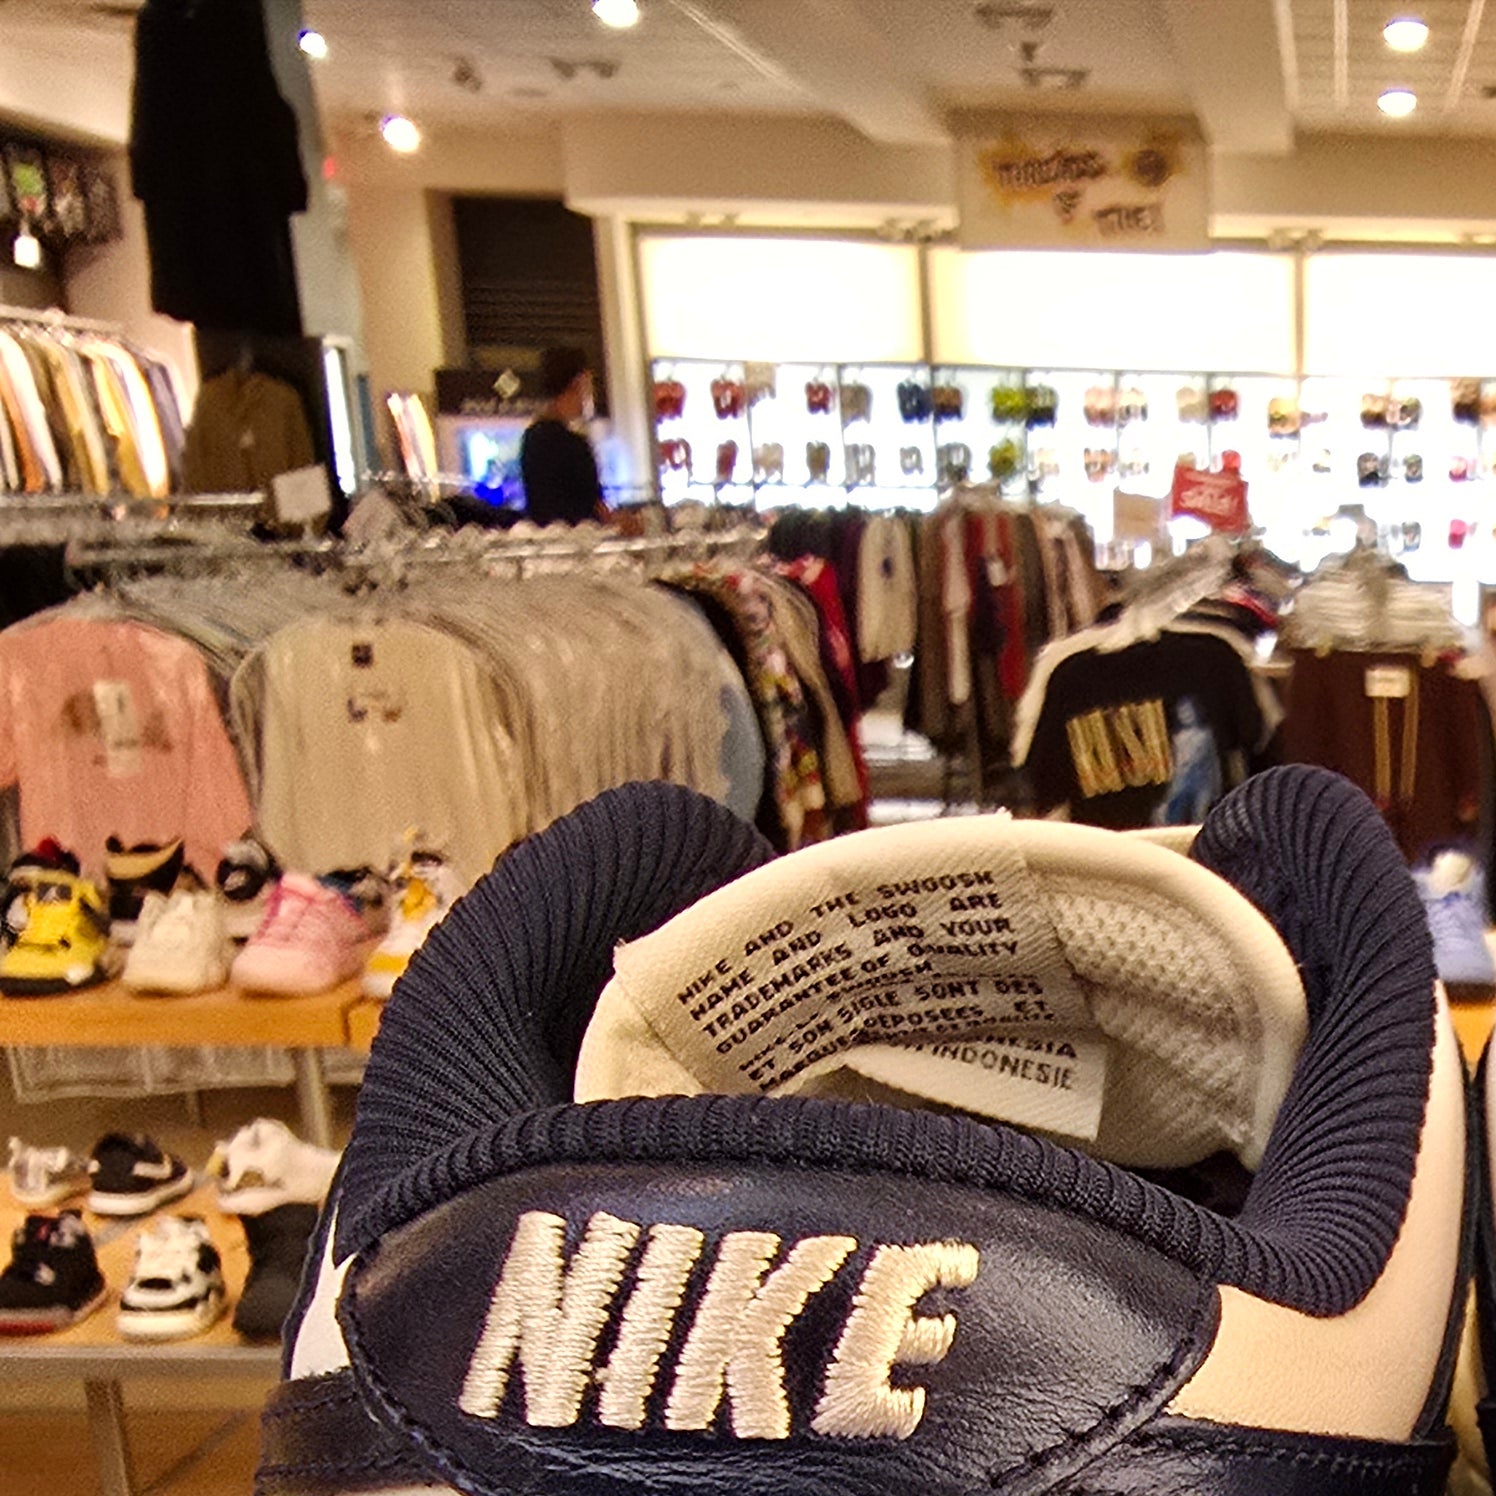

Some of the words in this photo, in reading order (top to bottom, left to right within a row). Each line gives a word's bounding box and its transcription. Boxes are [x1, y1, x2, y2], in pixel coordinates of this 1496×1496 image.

[677, 958, 733, 1004] NIKE
[744, 920, 794, 957] AND
[810, 891, 860, 918] THE
[876, 871, 995, 899] SWOOSH
[690, 967, 755, 1021] NAME
[772, 930, 823, 966] AND
[848, 902, 918, 928] LOGO
[950, 891, 1003, 912] ARE
[702, 941, 852, 1038] TRADEMARKS
[873, 924, 925, 947] AND
[940, 917, 1016, 937] YOUR
[716, 966, 858, 1054] GUARANTEE
[861, 952, 890, 973] OF
[907, 940, 1019, 957] QUALITY
[748, 1056, 776, 1081] ET
[788, 1018, 835, 1054] SON
[836, 990, 901, 1025] SIGLE
[914, 980, 980, 1001] SONT
[458, 1210, 980, 1440] NIKE
